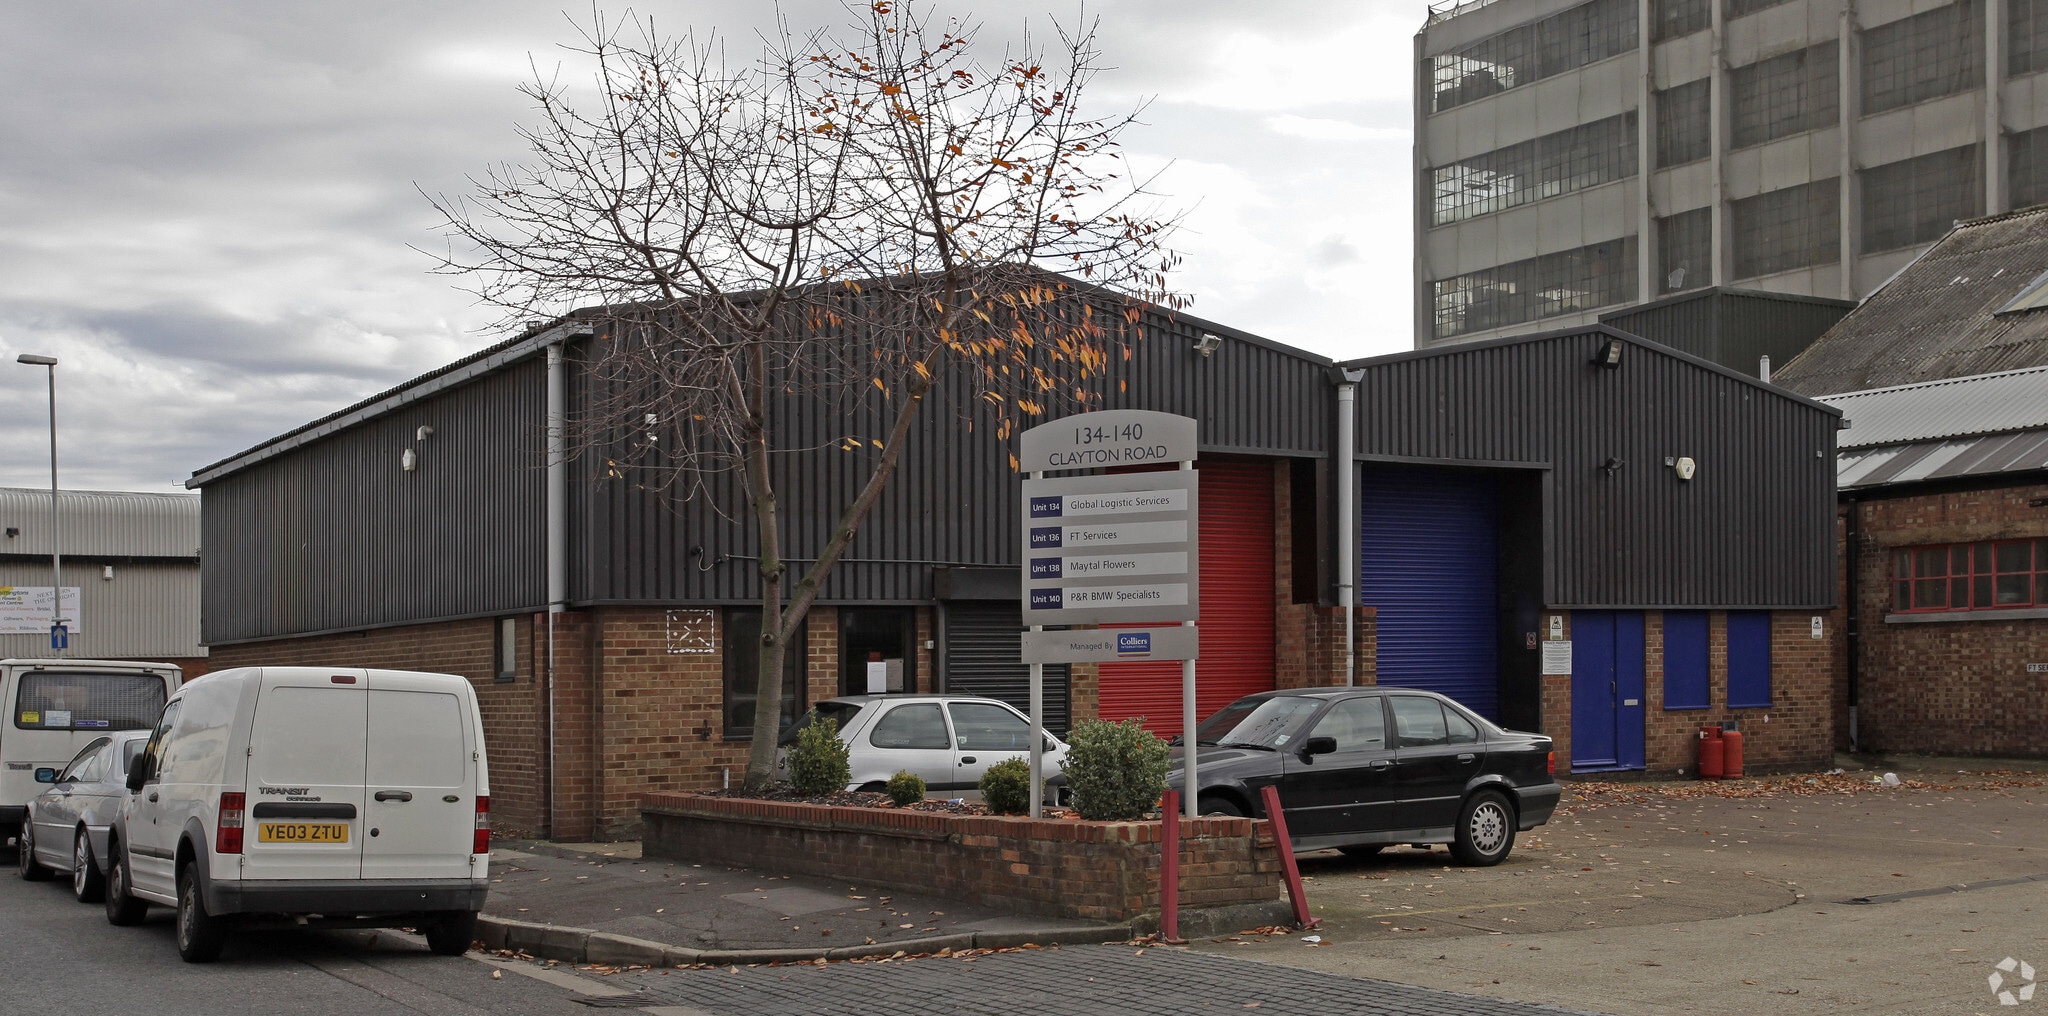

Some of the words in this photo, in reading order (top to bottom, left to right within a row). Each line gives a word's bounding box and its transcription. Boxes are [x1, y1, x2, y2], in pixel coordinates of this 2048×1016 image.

[1076, 424, 1142, 444] 134-140
[1049, 448, 1120, 466] CLAYTON
[1124, 446, 1167, 460] ROAD
[1070, 500, 1098, 509] Global
[1100, 498, 1132, 509] Logistic
[1136, 497, 1170, 506] Services
[1070, 532, 1080, 540] FT
[1084, 531, 1117, 540] Services
[1070, 561, 1100, 572] Maytal
[1103, 560, 1136, 569] Flowers
[1070, 592, 1088, 601] P&R
[1091, 592, 1113, 600] BMW
[1116, 590, 1160, 601] Specialists
[1070, 642, 1102, 651] Managed
[1120, 637, 1148, 645] Colliers
[259, 787, 310, 795] TRANSIT
[266, 825, 306, 840] YE03
